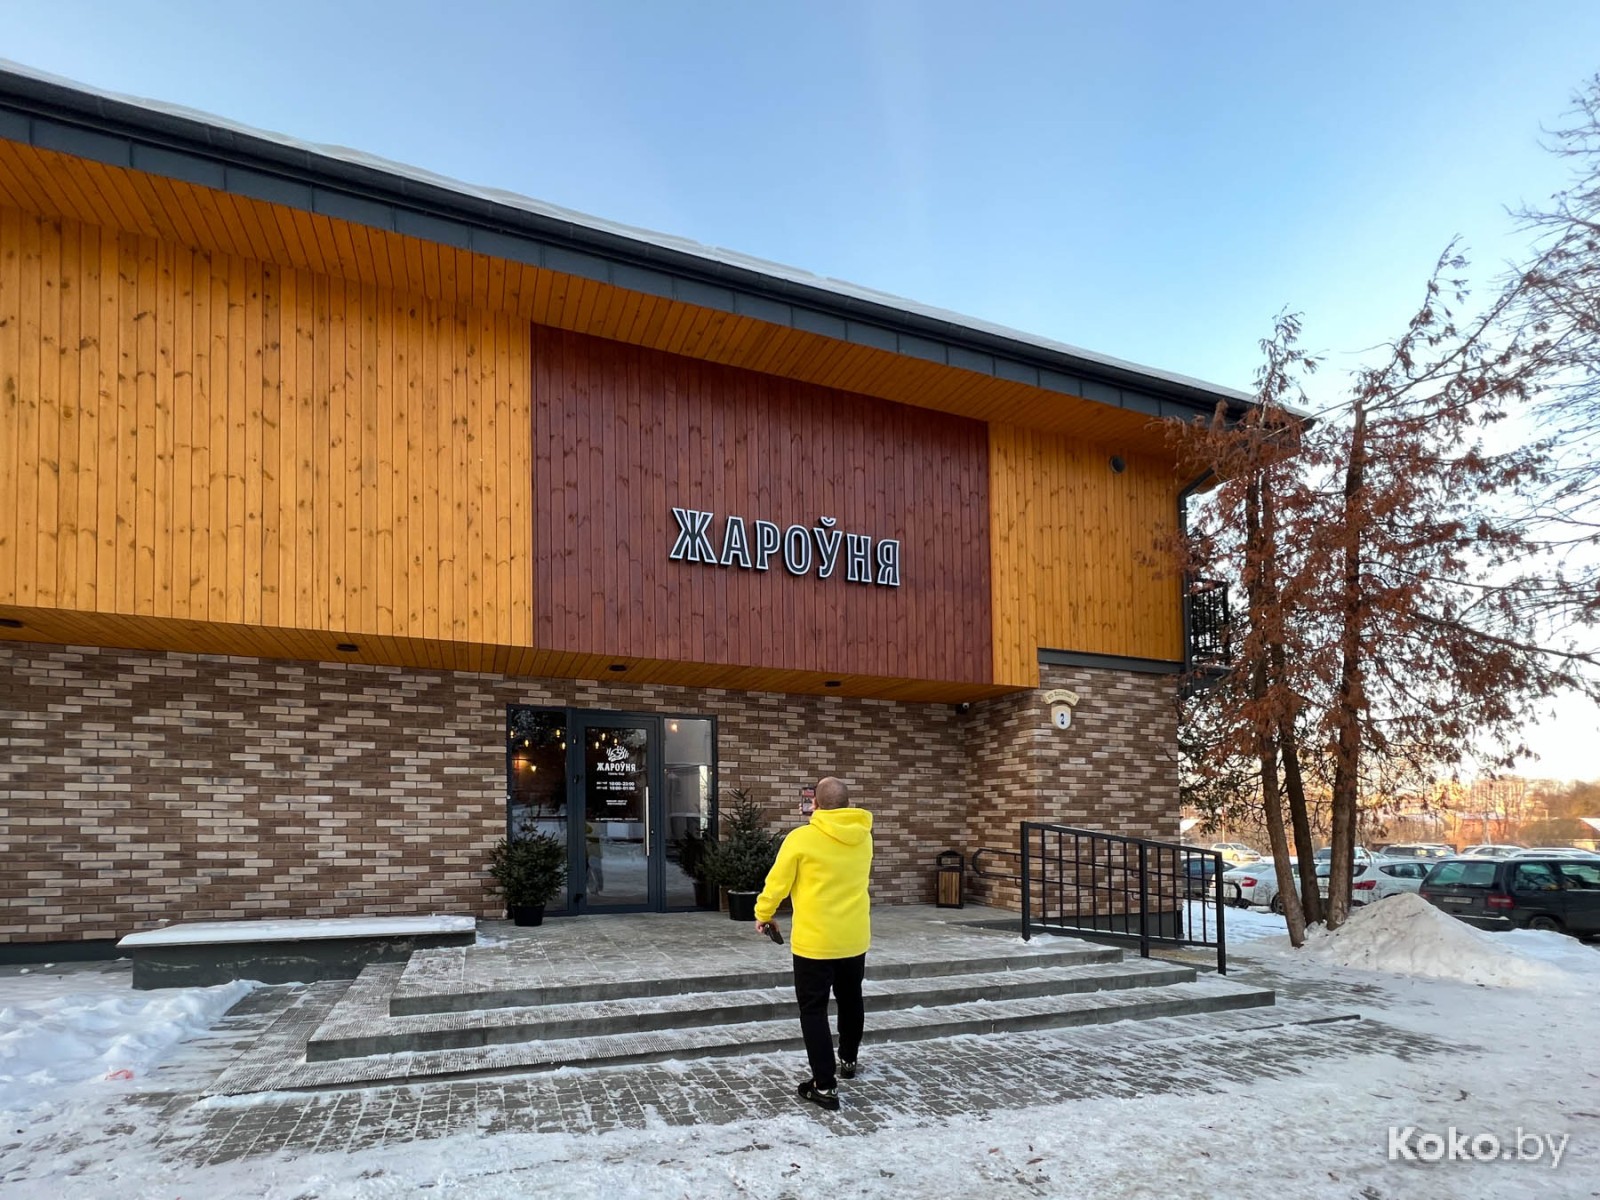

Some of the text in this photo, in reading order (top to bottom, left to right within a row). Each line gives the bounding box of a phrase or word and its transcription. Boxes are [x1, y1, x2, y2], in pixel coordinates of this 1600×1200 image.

[669, 507, 901, 587] ЖАРОЎНЯ
[1060, 713, 1065, 725] 2
[596, 761, 636, 772] ЖАРОЎНЯ
